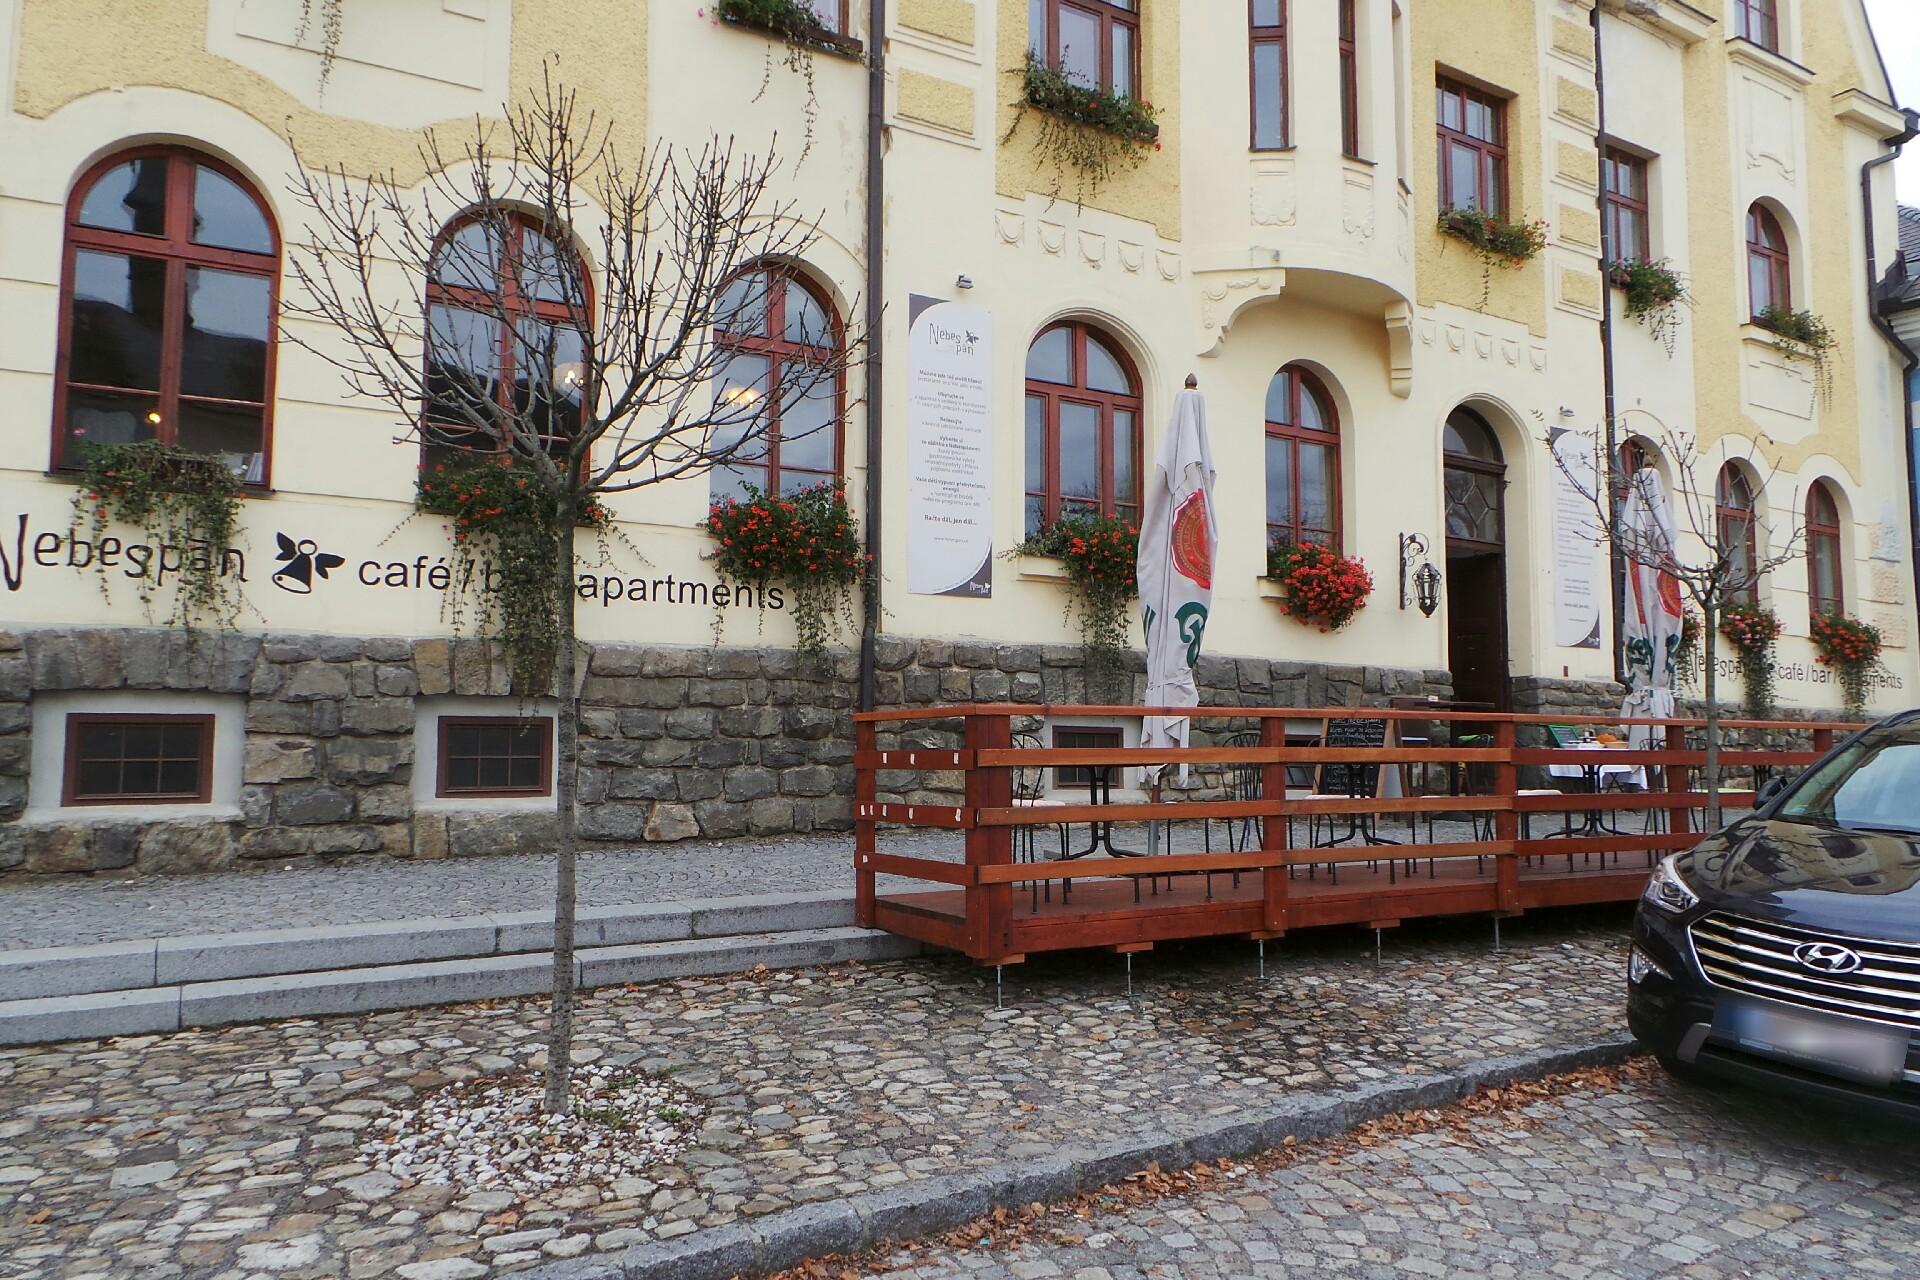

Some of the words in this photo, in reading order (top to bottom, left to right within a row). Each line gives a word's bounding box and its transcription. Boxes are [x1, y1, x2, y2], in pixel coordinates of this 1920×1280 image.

[929, 322, 962, 344] Nebes
[358, 555, 451, 591] café
[577, 573, 785, 610] apartments
[1777, 663, 1804, 681] café
[1811, 667, 1831, 684] bar
